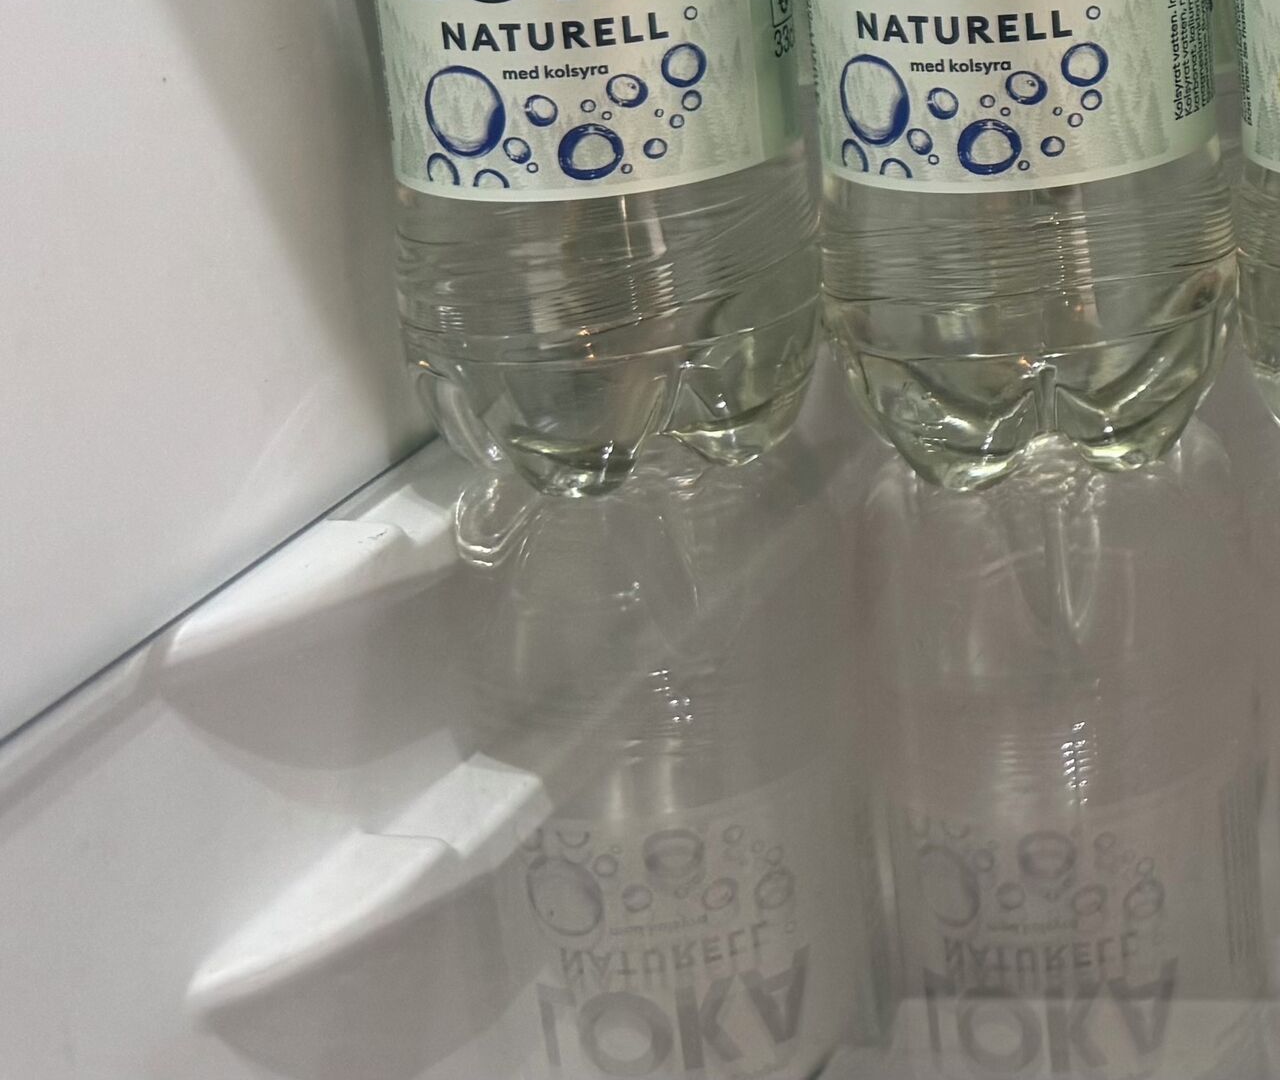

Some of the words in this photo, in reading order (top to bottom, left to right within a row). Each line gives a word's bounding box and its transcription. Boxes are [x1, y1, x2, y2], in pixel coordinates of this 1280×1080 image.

[441, 12, 669, 52] NATURELL
[856, 9, 1073, 44] NATURELL
[1168, 11, 1180, 62] vatten.
[502, 66, 540, 81] med
[544, 63, 609, 82] kolsyra
[910, 58, 946, 73] med
[949, 57, 1012, 76] kolsyra
[1169, 63, 1183, 121] Kolsyrat
